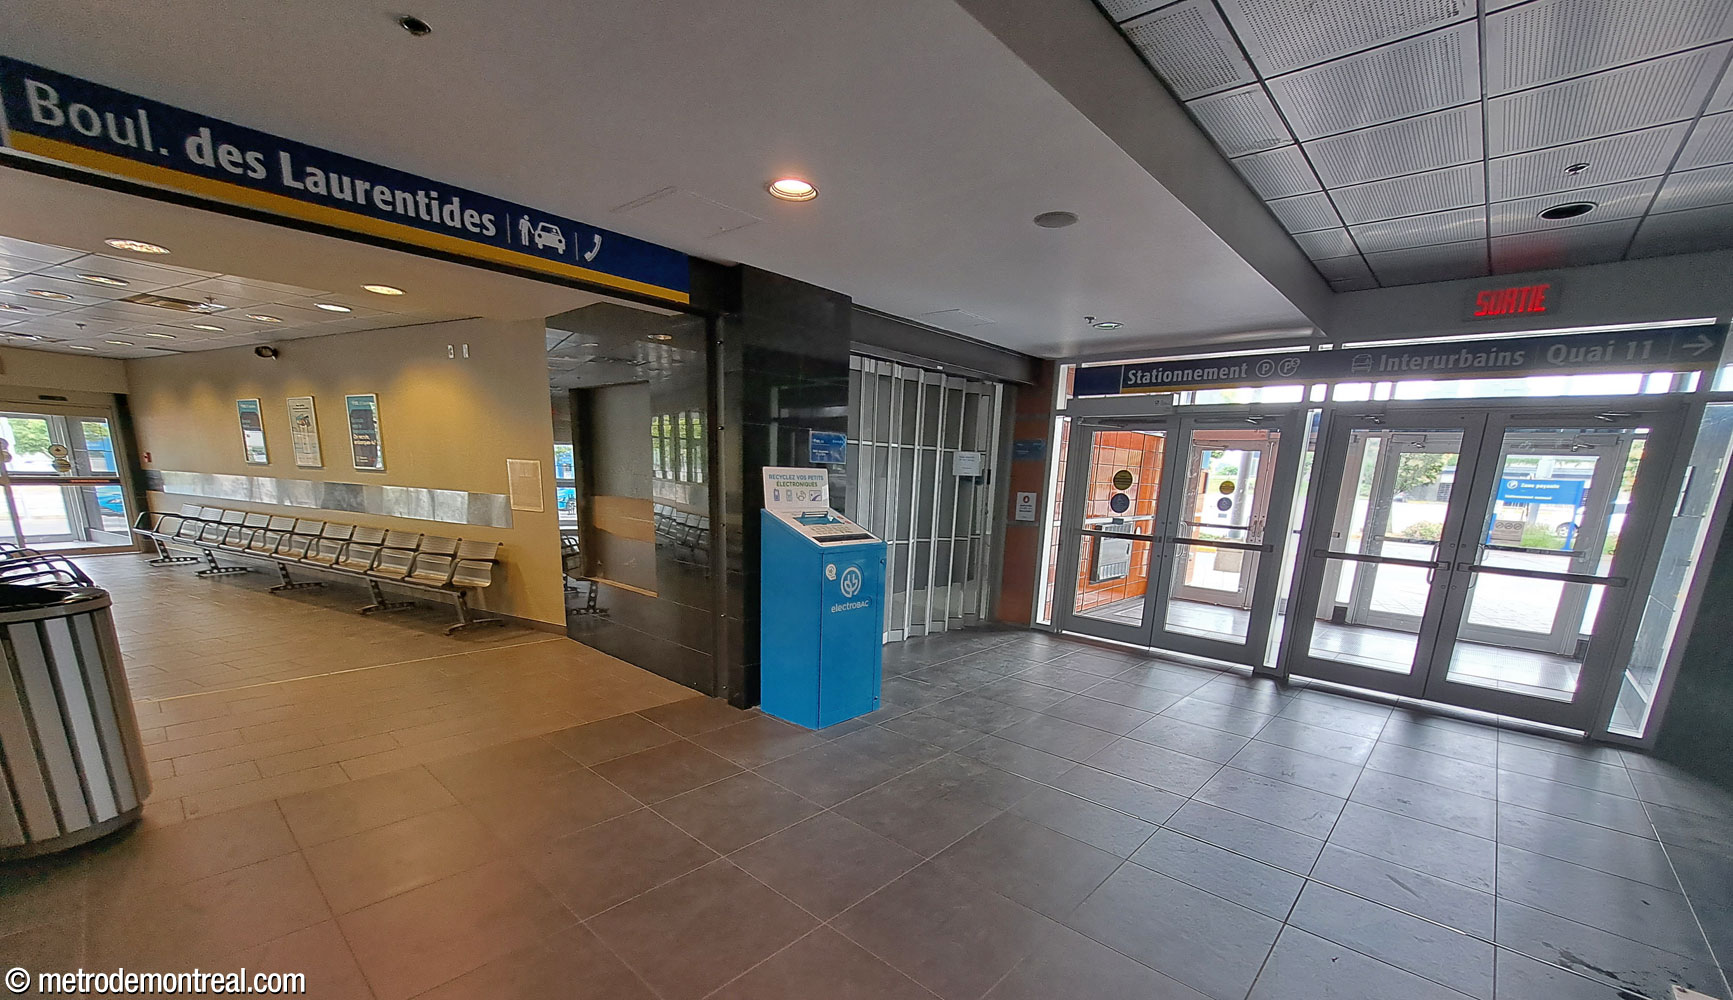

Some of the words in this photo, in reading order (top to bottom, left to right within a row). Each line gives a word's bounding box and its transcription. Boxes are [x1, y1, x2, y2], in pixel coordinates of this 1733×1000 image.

[24, 77, 169, 156] Boul.
[185, 127, 267, 180] des
[279, 151, 496, 237] Laurentides
[1473, 284, 1550, 316] SORTIE
[1379, 347, 1525, 373] Interurbains
[1546, 340, 1614, 365] Quai
[1625, 340, 1654, 361] 11
[1127, 362, 1248, 385] Stationnement
